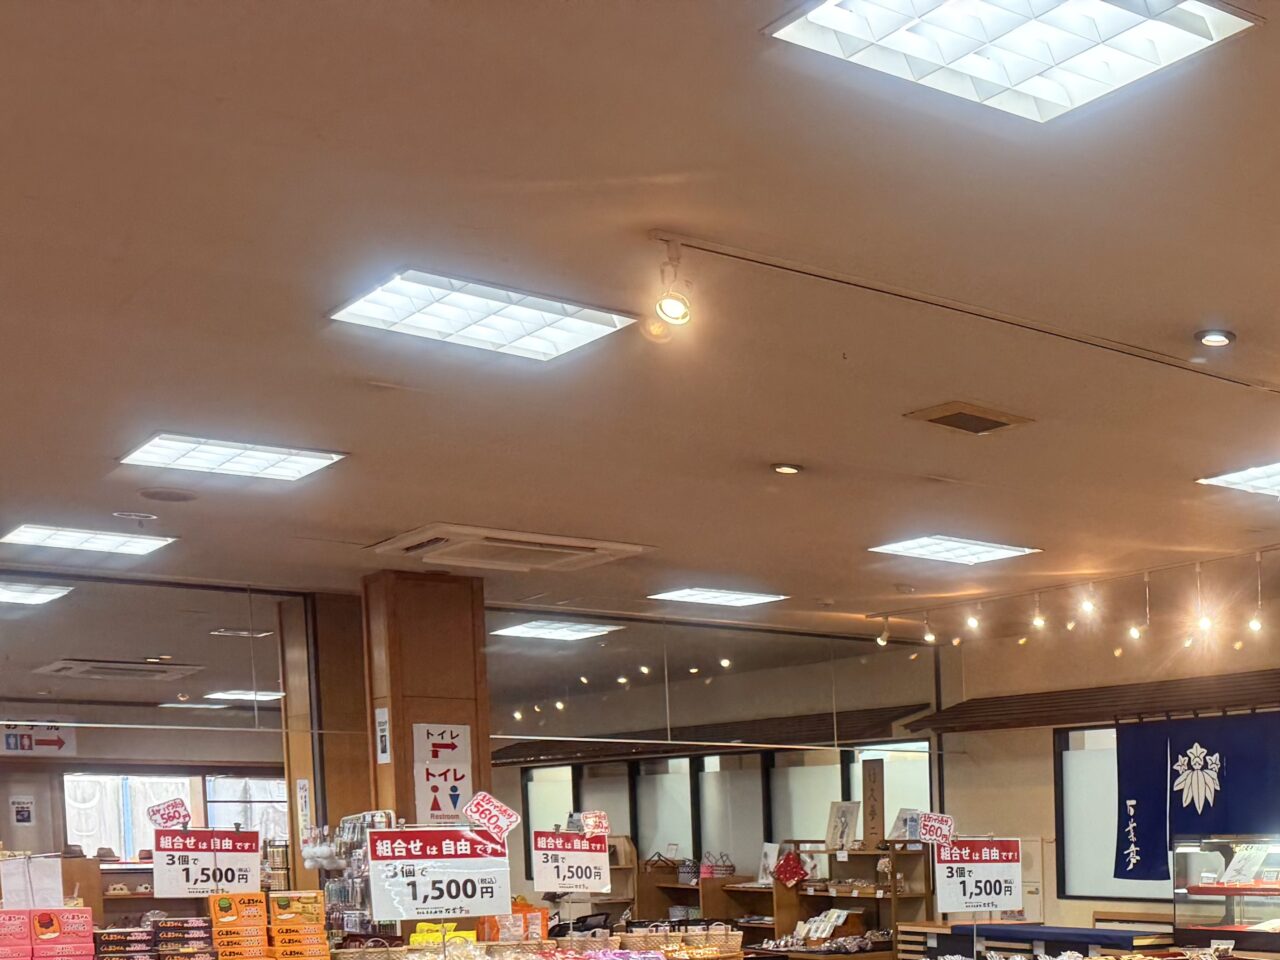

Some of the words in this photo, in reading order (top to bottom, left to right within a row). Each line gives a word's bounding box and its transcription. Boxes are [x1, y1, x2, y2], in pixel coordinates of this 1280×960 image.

[426, 729, 460, 740] トイレ
[425, 768, 466, 782] トイレ
[469, 801, 505, 835] 560円
[921, 824, 948, 842] 560円
[165, 854, 199, 866] 3個で
[541, 852, 566, 864] 3個で
[181, 867, 249, 885] 1,500円
[385, 863, 428, 879] 3個で
[553, 864, 602, 882] 1,500円
[945, 866, 974, 879] 3個で
[406, 878, 495, 904] 1,500円
[959, 879, 1013, 899] 1,500円
